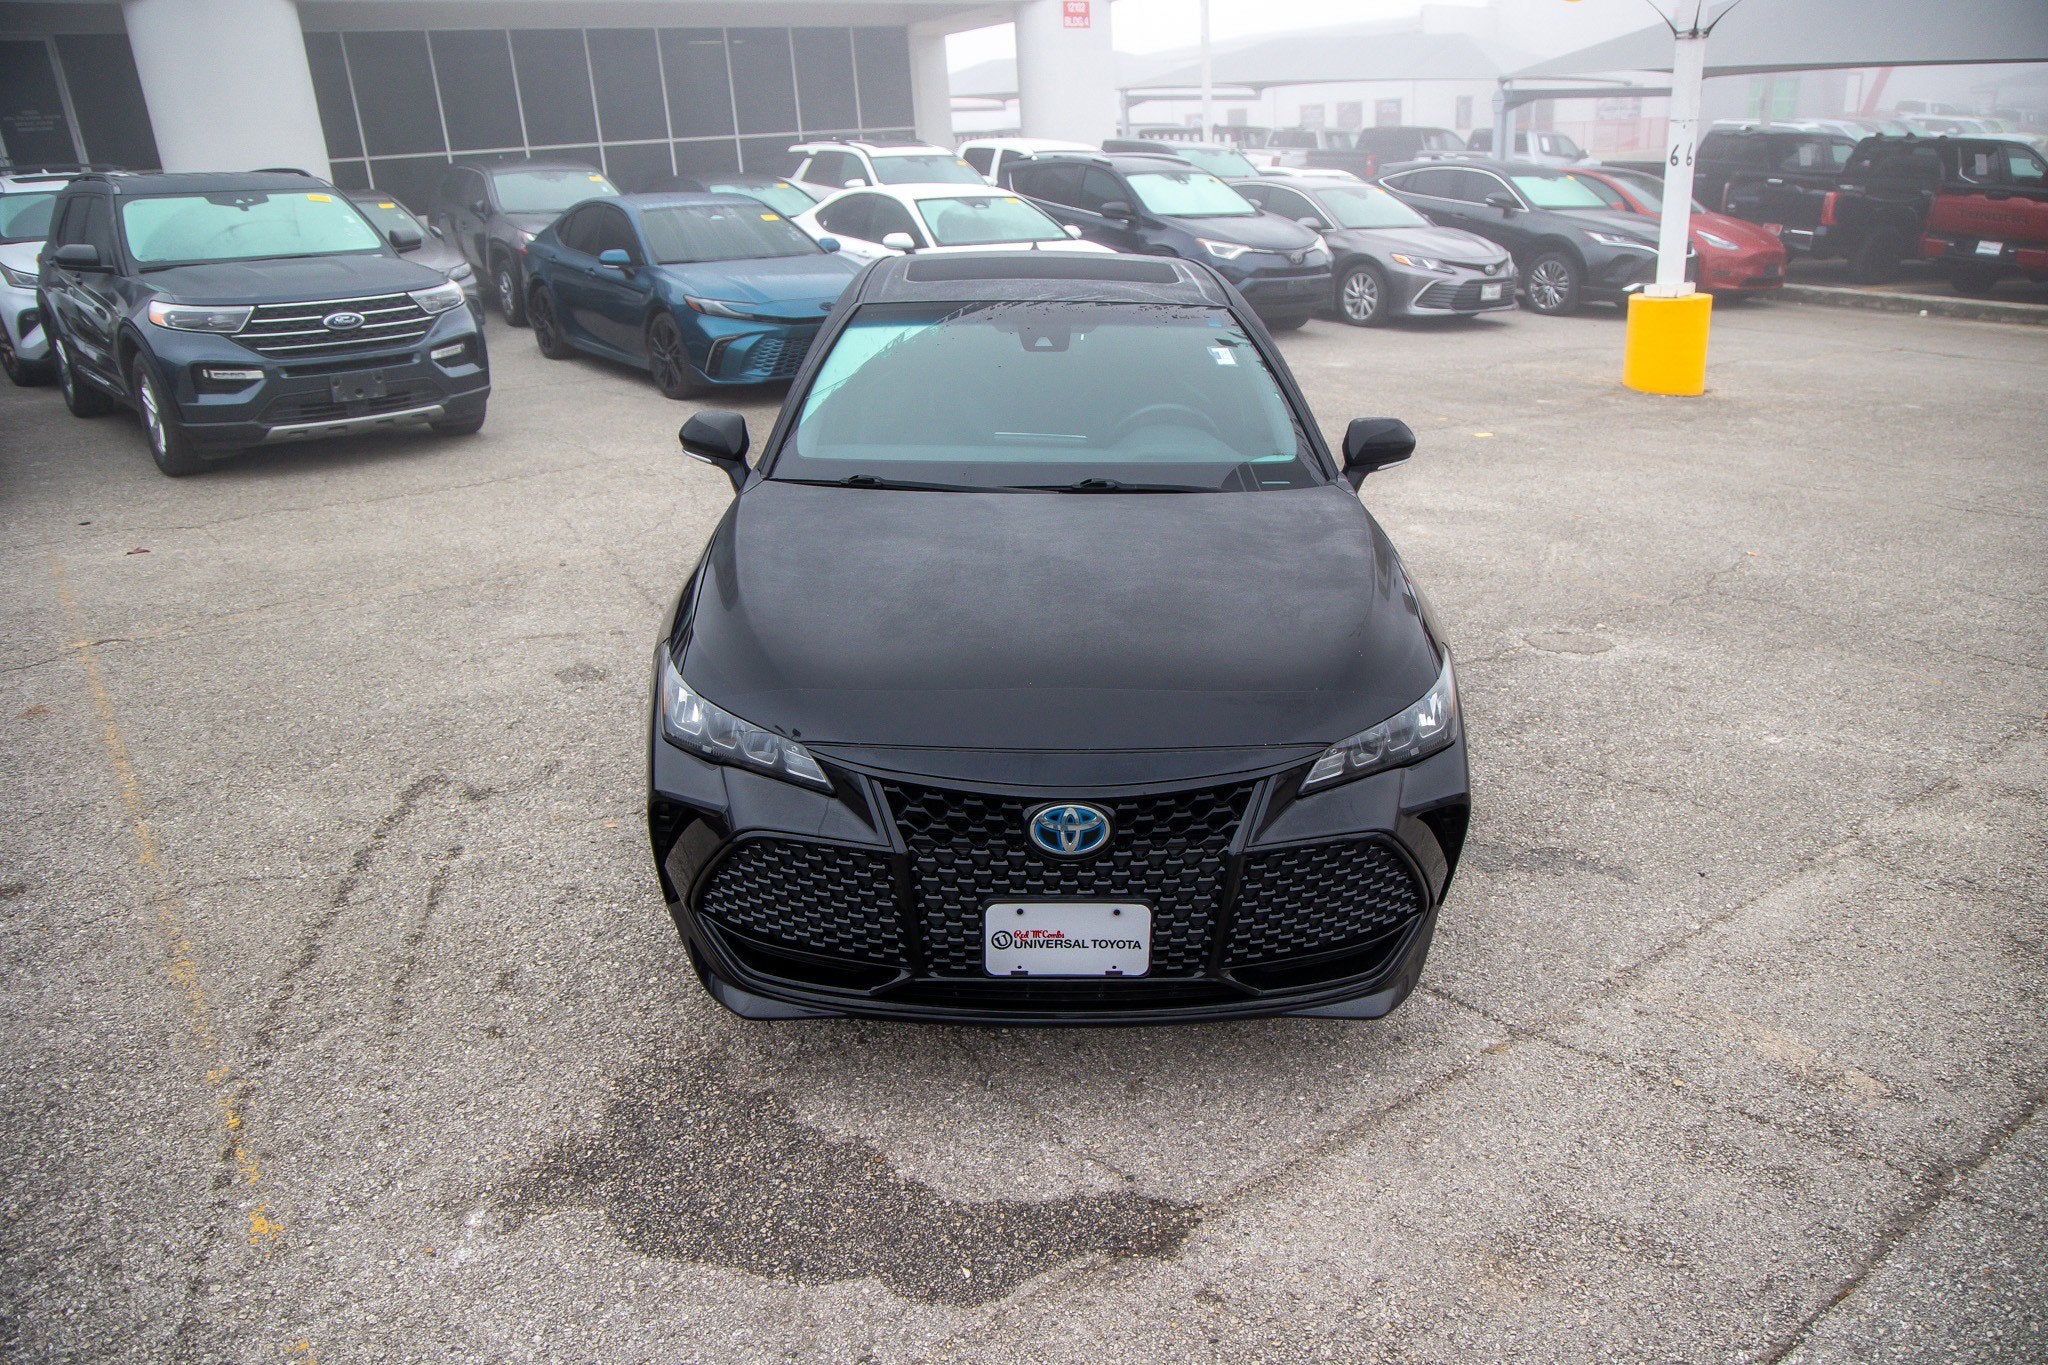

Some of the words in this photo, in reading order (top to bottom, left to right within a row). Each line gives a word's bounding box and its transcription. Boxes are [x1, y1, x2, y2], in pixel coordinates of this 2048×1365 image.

[1013, 929, 1029, 941] Red
[1014, 939, 1089, 949] UNIVERSAL
[1090, 939, 1142, 950] TOYOTA
